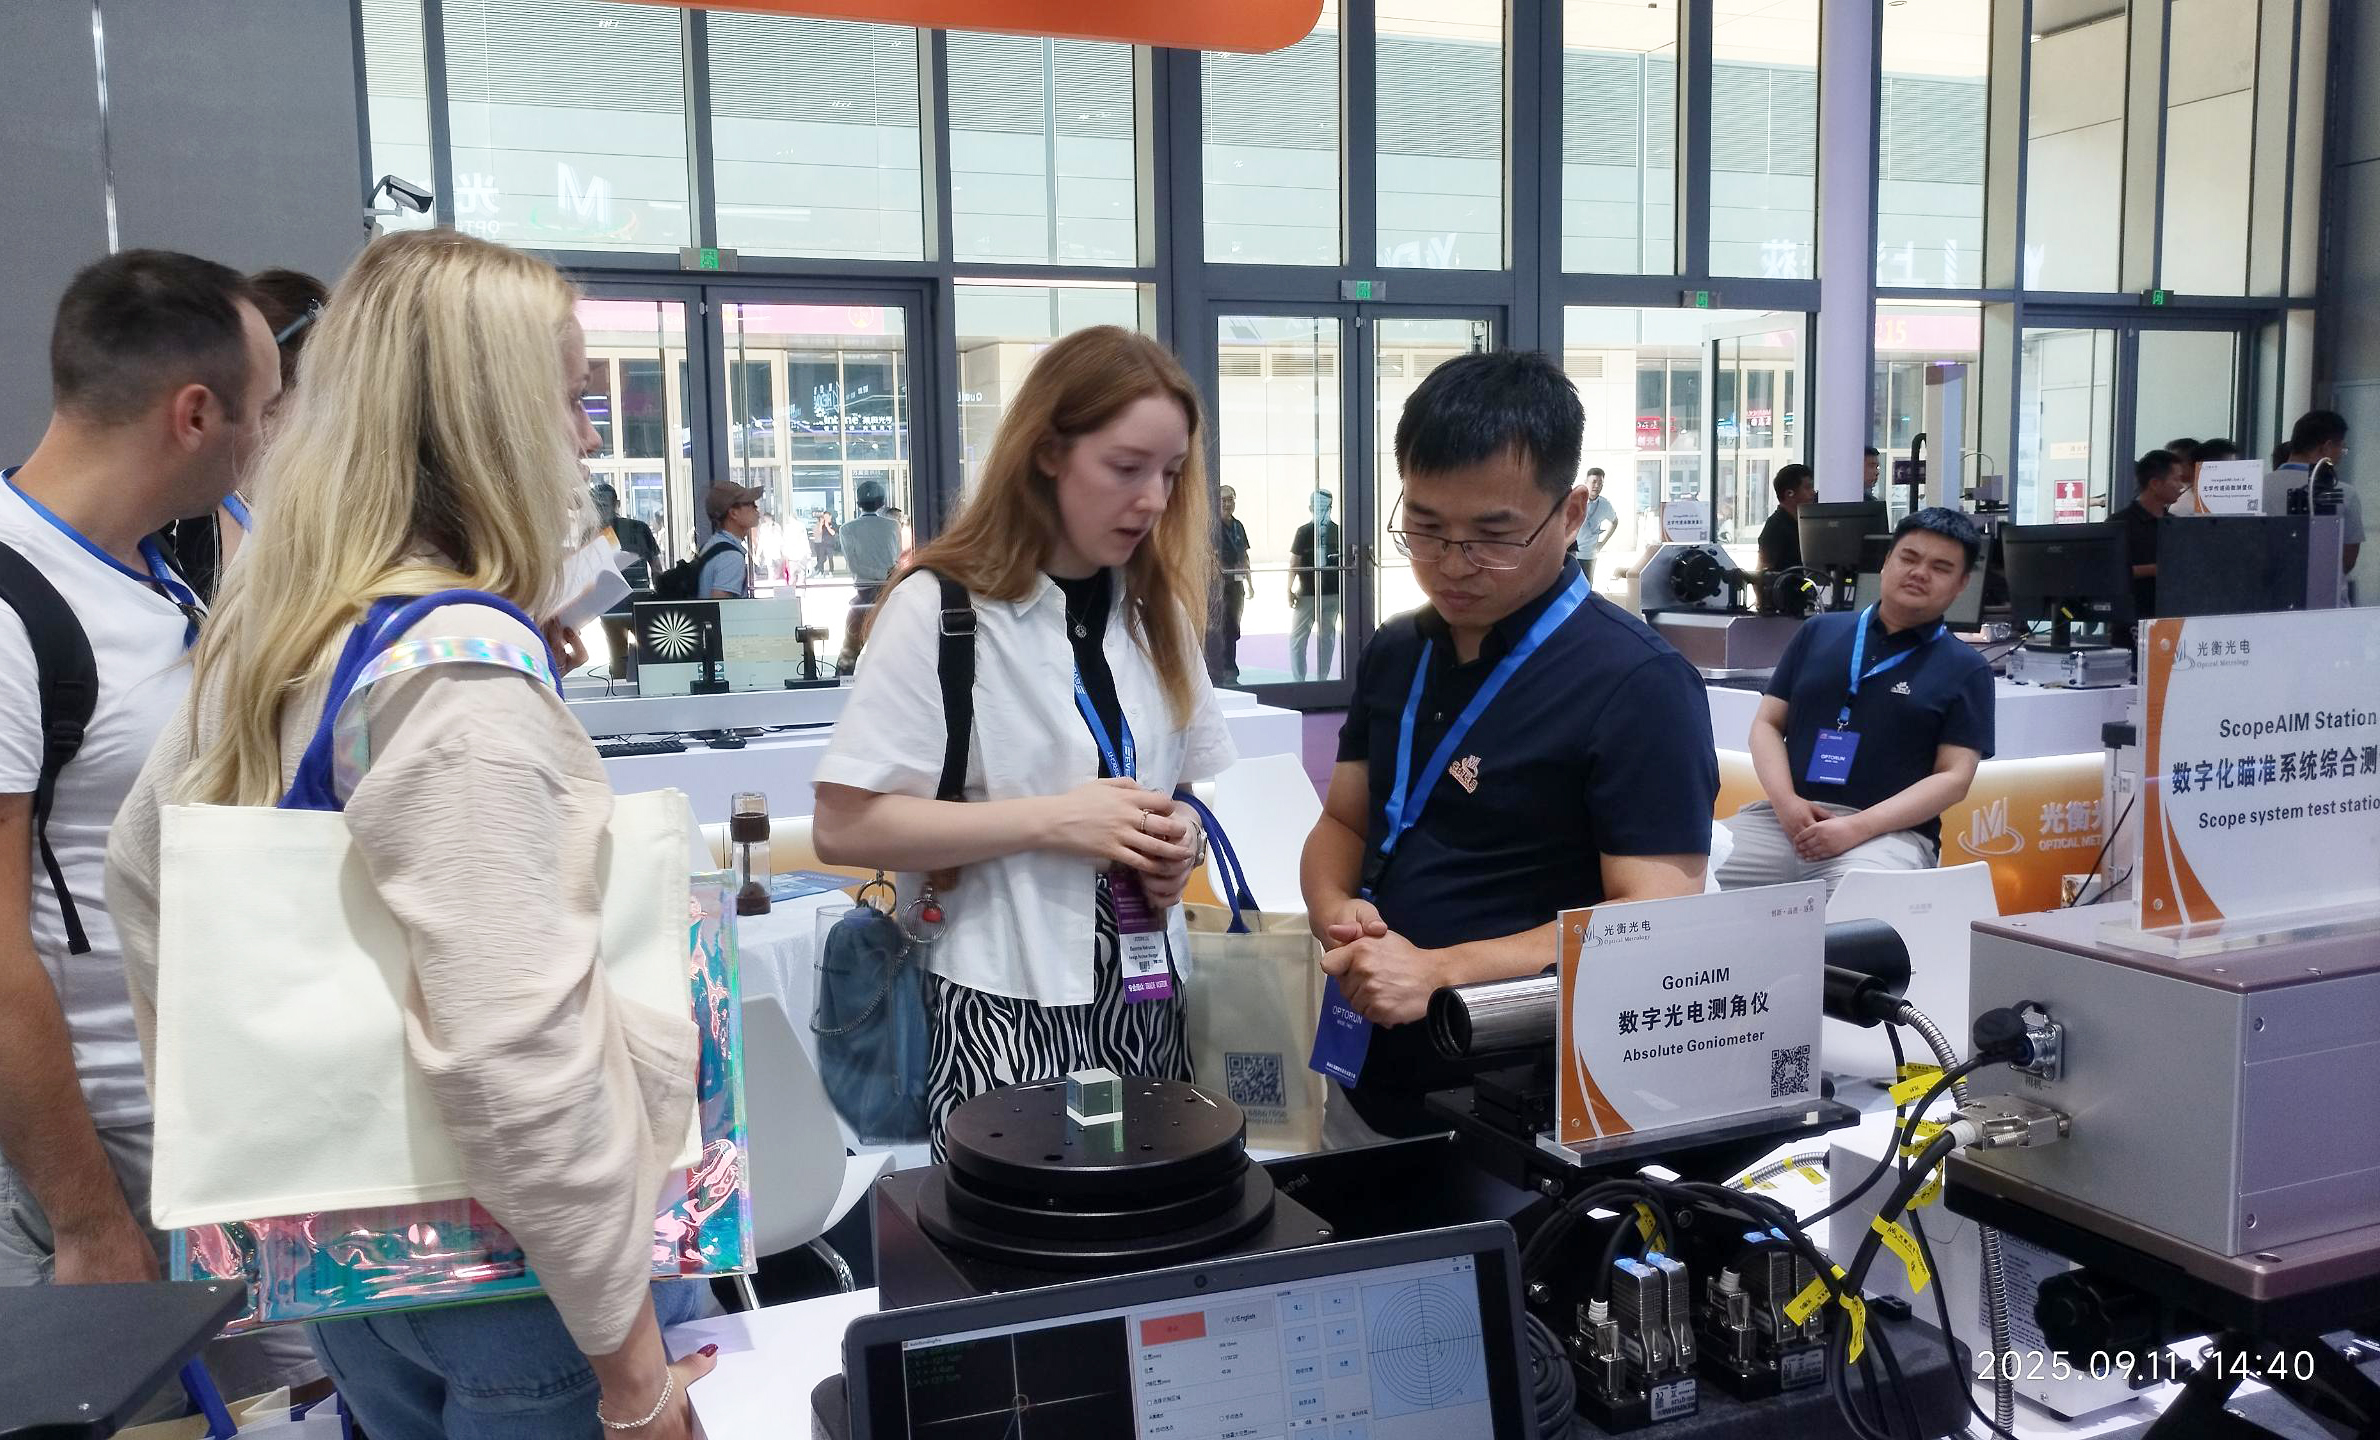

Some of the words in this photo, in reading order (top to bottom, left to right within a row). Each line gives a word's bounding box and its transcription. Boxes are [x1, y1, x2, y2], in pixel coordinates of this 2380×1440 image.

[2197, 639, 2251, 657] 光衡光电
[2219, 712, 2310, 740] ScopeAIM
[2315, 708, 2377, 730] Station
[2172, 744, 2378, 795] 数字化瞄准系统综合测
[2199, 812, 2246, 829] Scope
[2250, 805, 2303, 826] system
[2308, 800, 2336, 817] test
[2039, 839, 2079, 851] OPTICAL
[1604, 920, 1651, 937] 光衡光电
[1662, 967, 1730, 990] GoniAIM
[1332, 1005, 1363, 1025] OPTORUN
[1618, 991, 1770, 1036] 数字光电测角仪
[1623, 1044, 1683, 1063] Absolute
[1687, 1031, 1765, 1052] Goniometer
